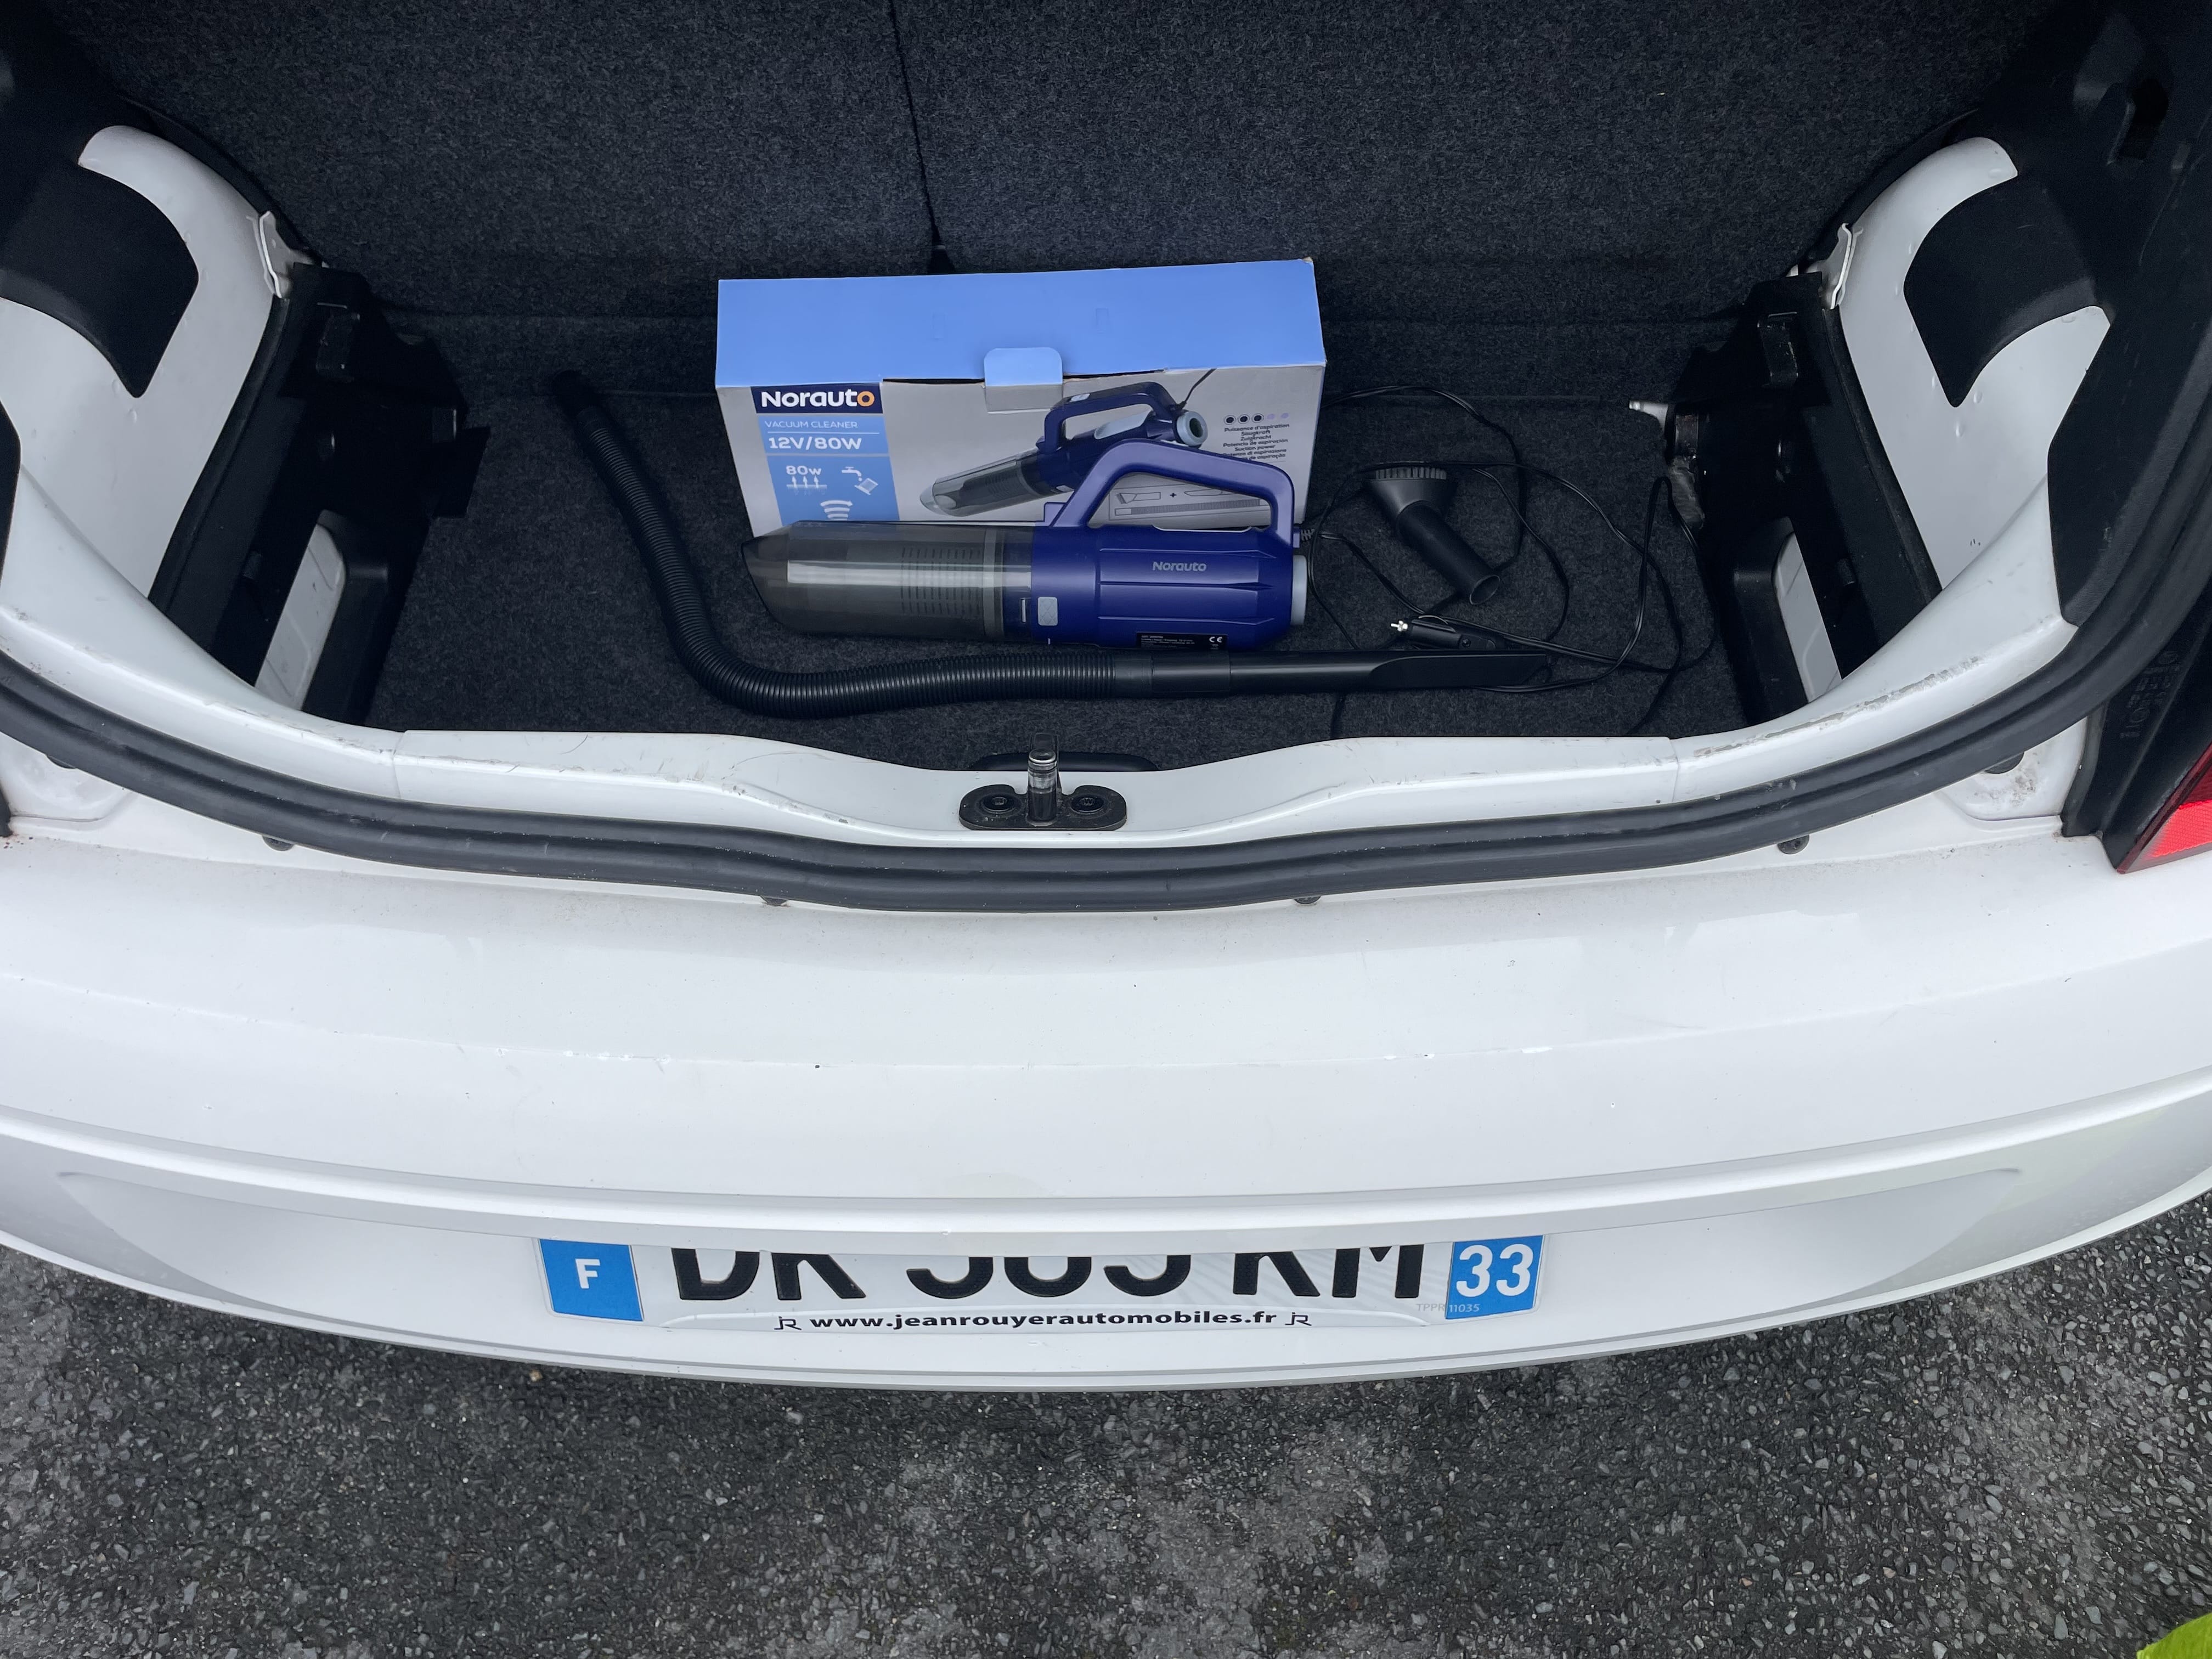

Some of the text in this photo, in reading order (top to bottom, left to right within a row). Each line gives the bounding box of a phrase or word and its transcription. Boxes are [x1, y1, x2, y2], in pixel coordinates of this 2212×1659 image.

[761, 389, 875, 408] Norauto
[765, 420, 859, 429] VACUUM CLEANER
[769, 437, 862, 450] 12V/80W
[1152, 561, 1207, 572] Norauto
[575, 1258, 601, 1289] F
[1455, 1243, 1534, 1297] 33
[809, 1311, 1277, 1329] www.jeanrouyerautomobiles.fr
